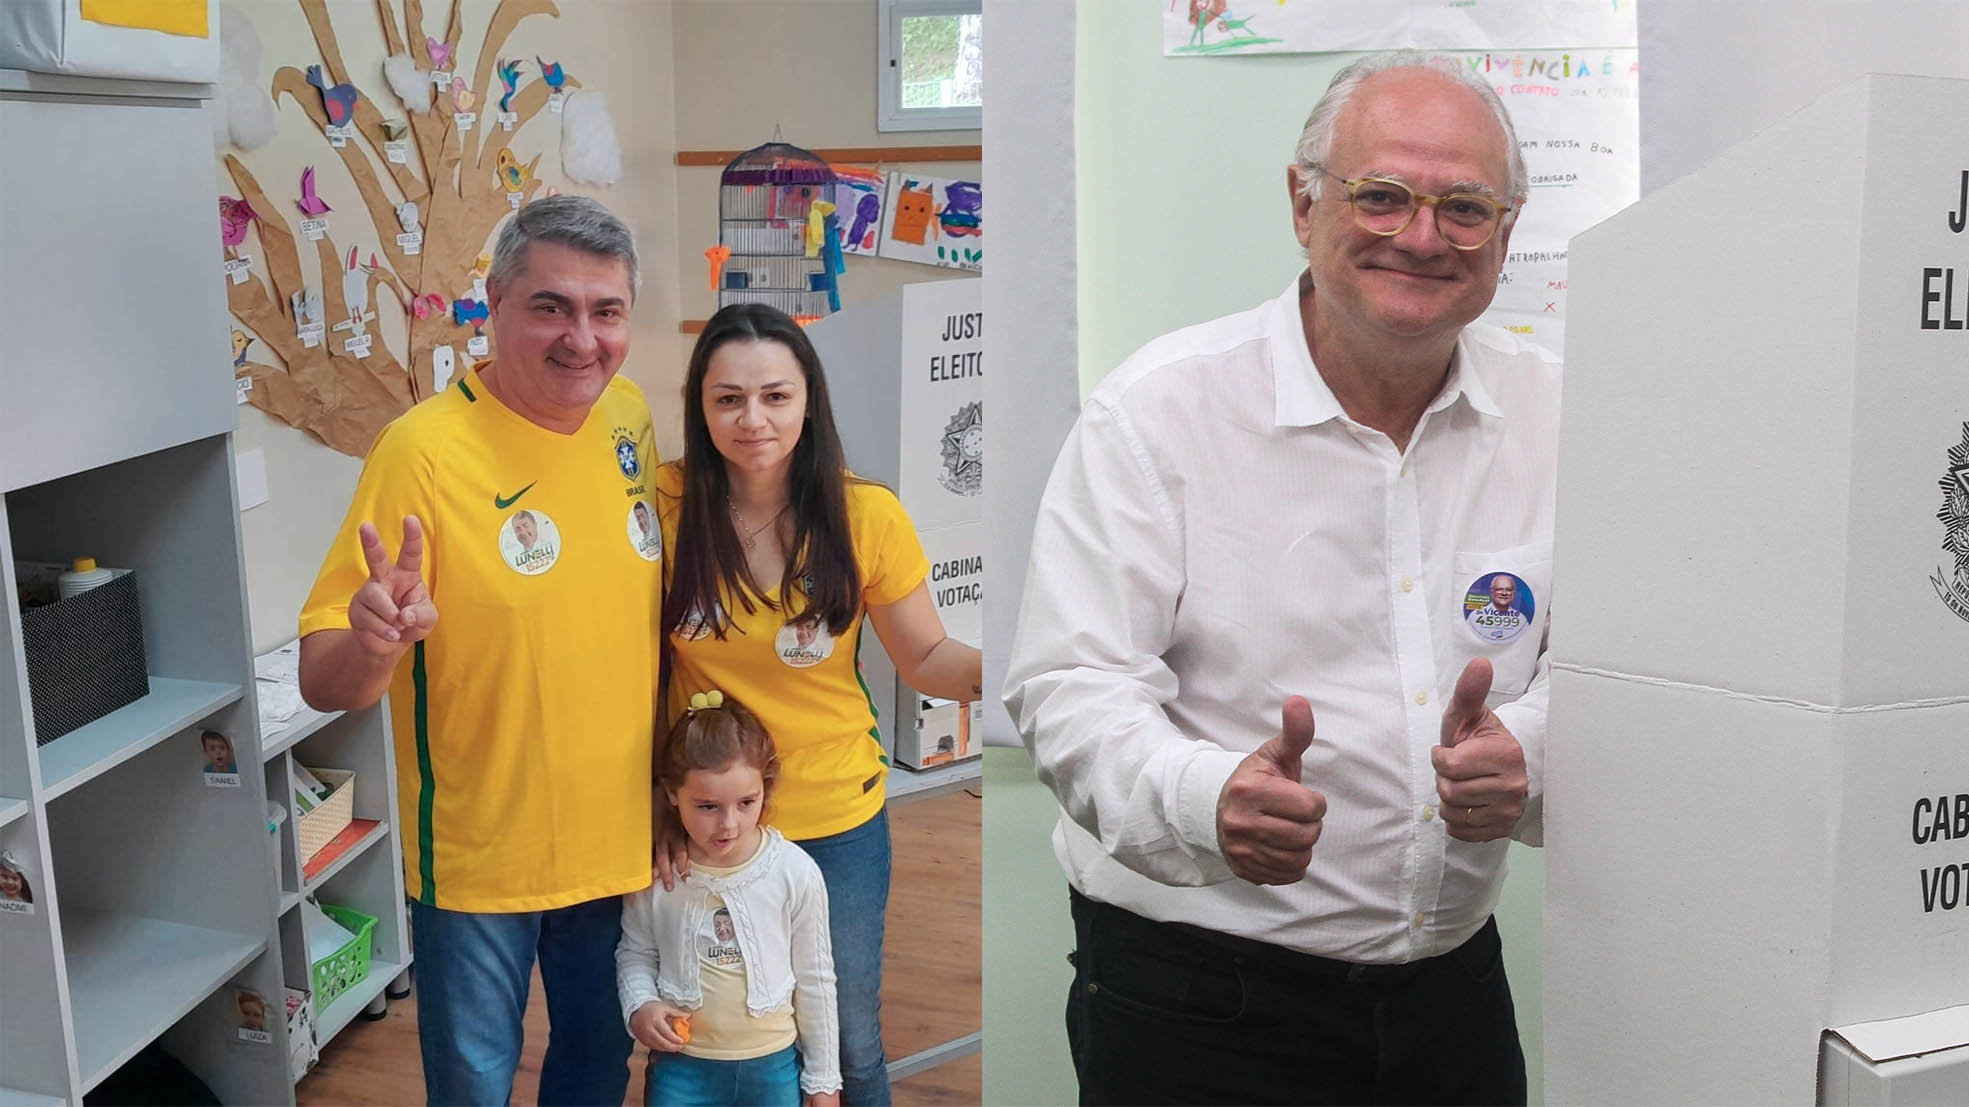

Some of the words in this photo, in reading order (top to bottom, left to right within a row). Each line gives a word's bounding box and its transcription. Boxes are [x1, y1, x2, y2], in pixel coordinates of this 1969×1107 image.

[1545, 140, 1580, 149] NOSSA
[1590, 142, 1613, 154] BOA
[1530, 174, 1578, 184] OBRIGADA
[1920, 267, 1969, 330] EL
[942, 312, 983, 341] JUST
[932, 555, 983, 582] CABINA
[937, 583, 983, 608] VOTAÇ
[1475, 615, 1520, 627] 45999
[1912, 793, 1969, 845] CAB
